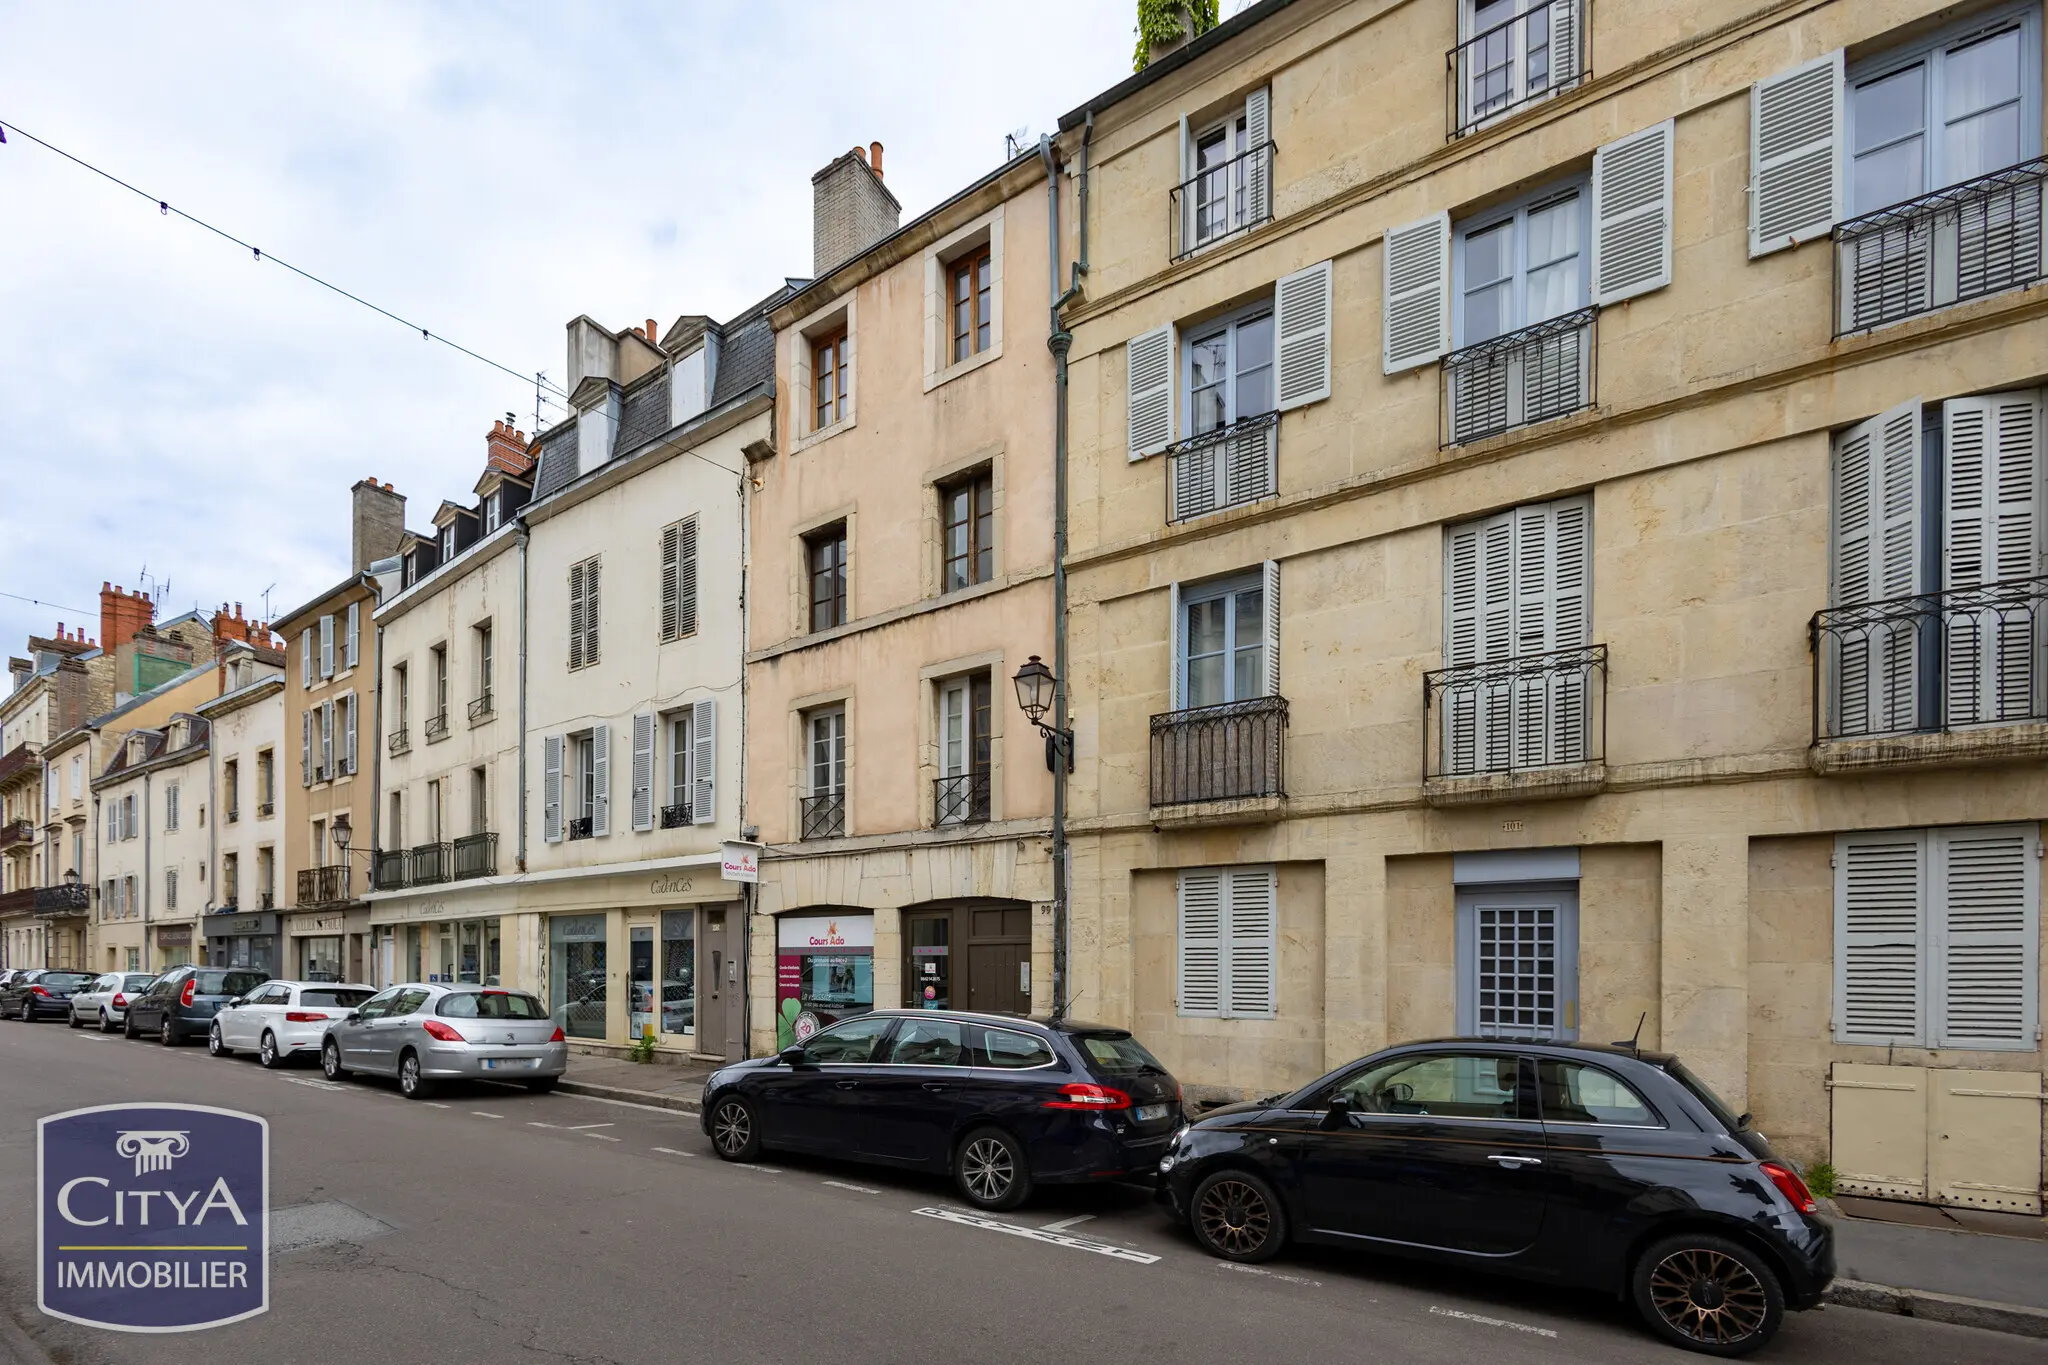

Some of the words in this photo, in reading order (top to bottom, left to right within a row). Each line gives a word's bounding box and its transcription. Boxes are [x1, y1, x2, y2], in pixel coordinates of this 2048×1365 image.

[1506, 822, 1520, 831] 101
[724, 862, 742, 871] Cours
[743, 864, 757, 873] Ado
[1040, 905, 1051, 915] 99
[809, 936, 828, 946] Cours
[829, 936, 845, 946] Ado
[800, 1021, 811, 1034] 20
